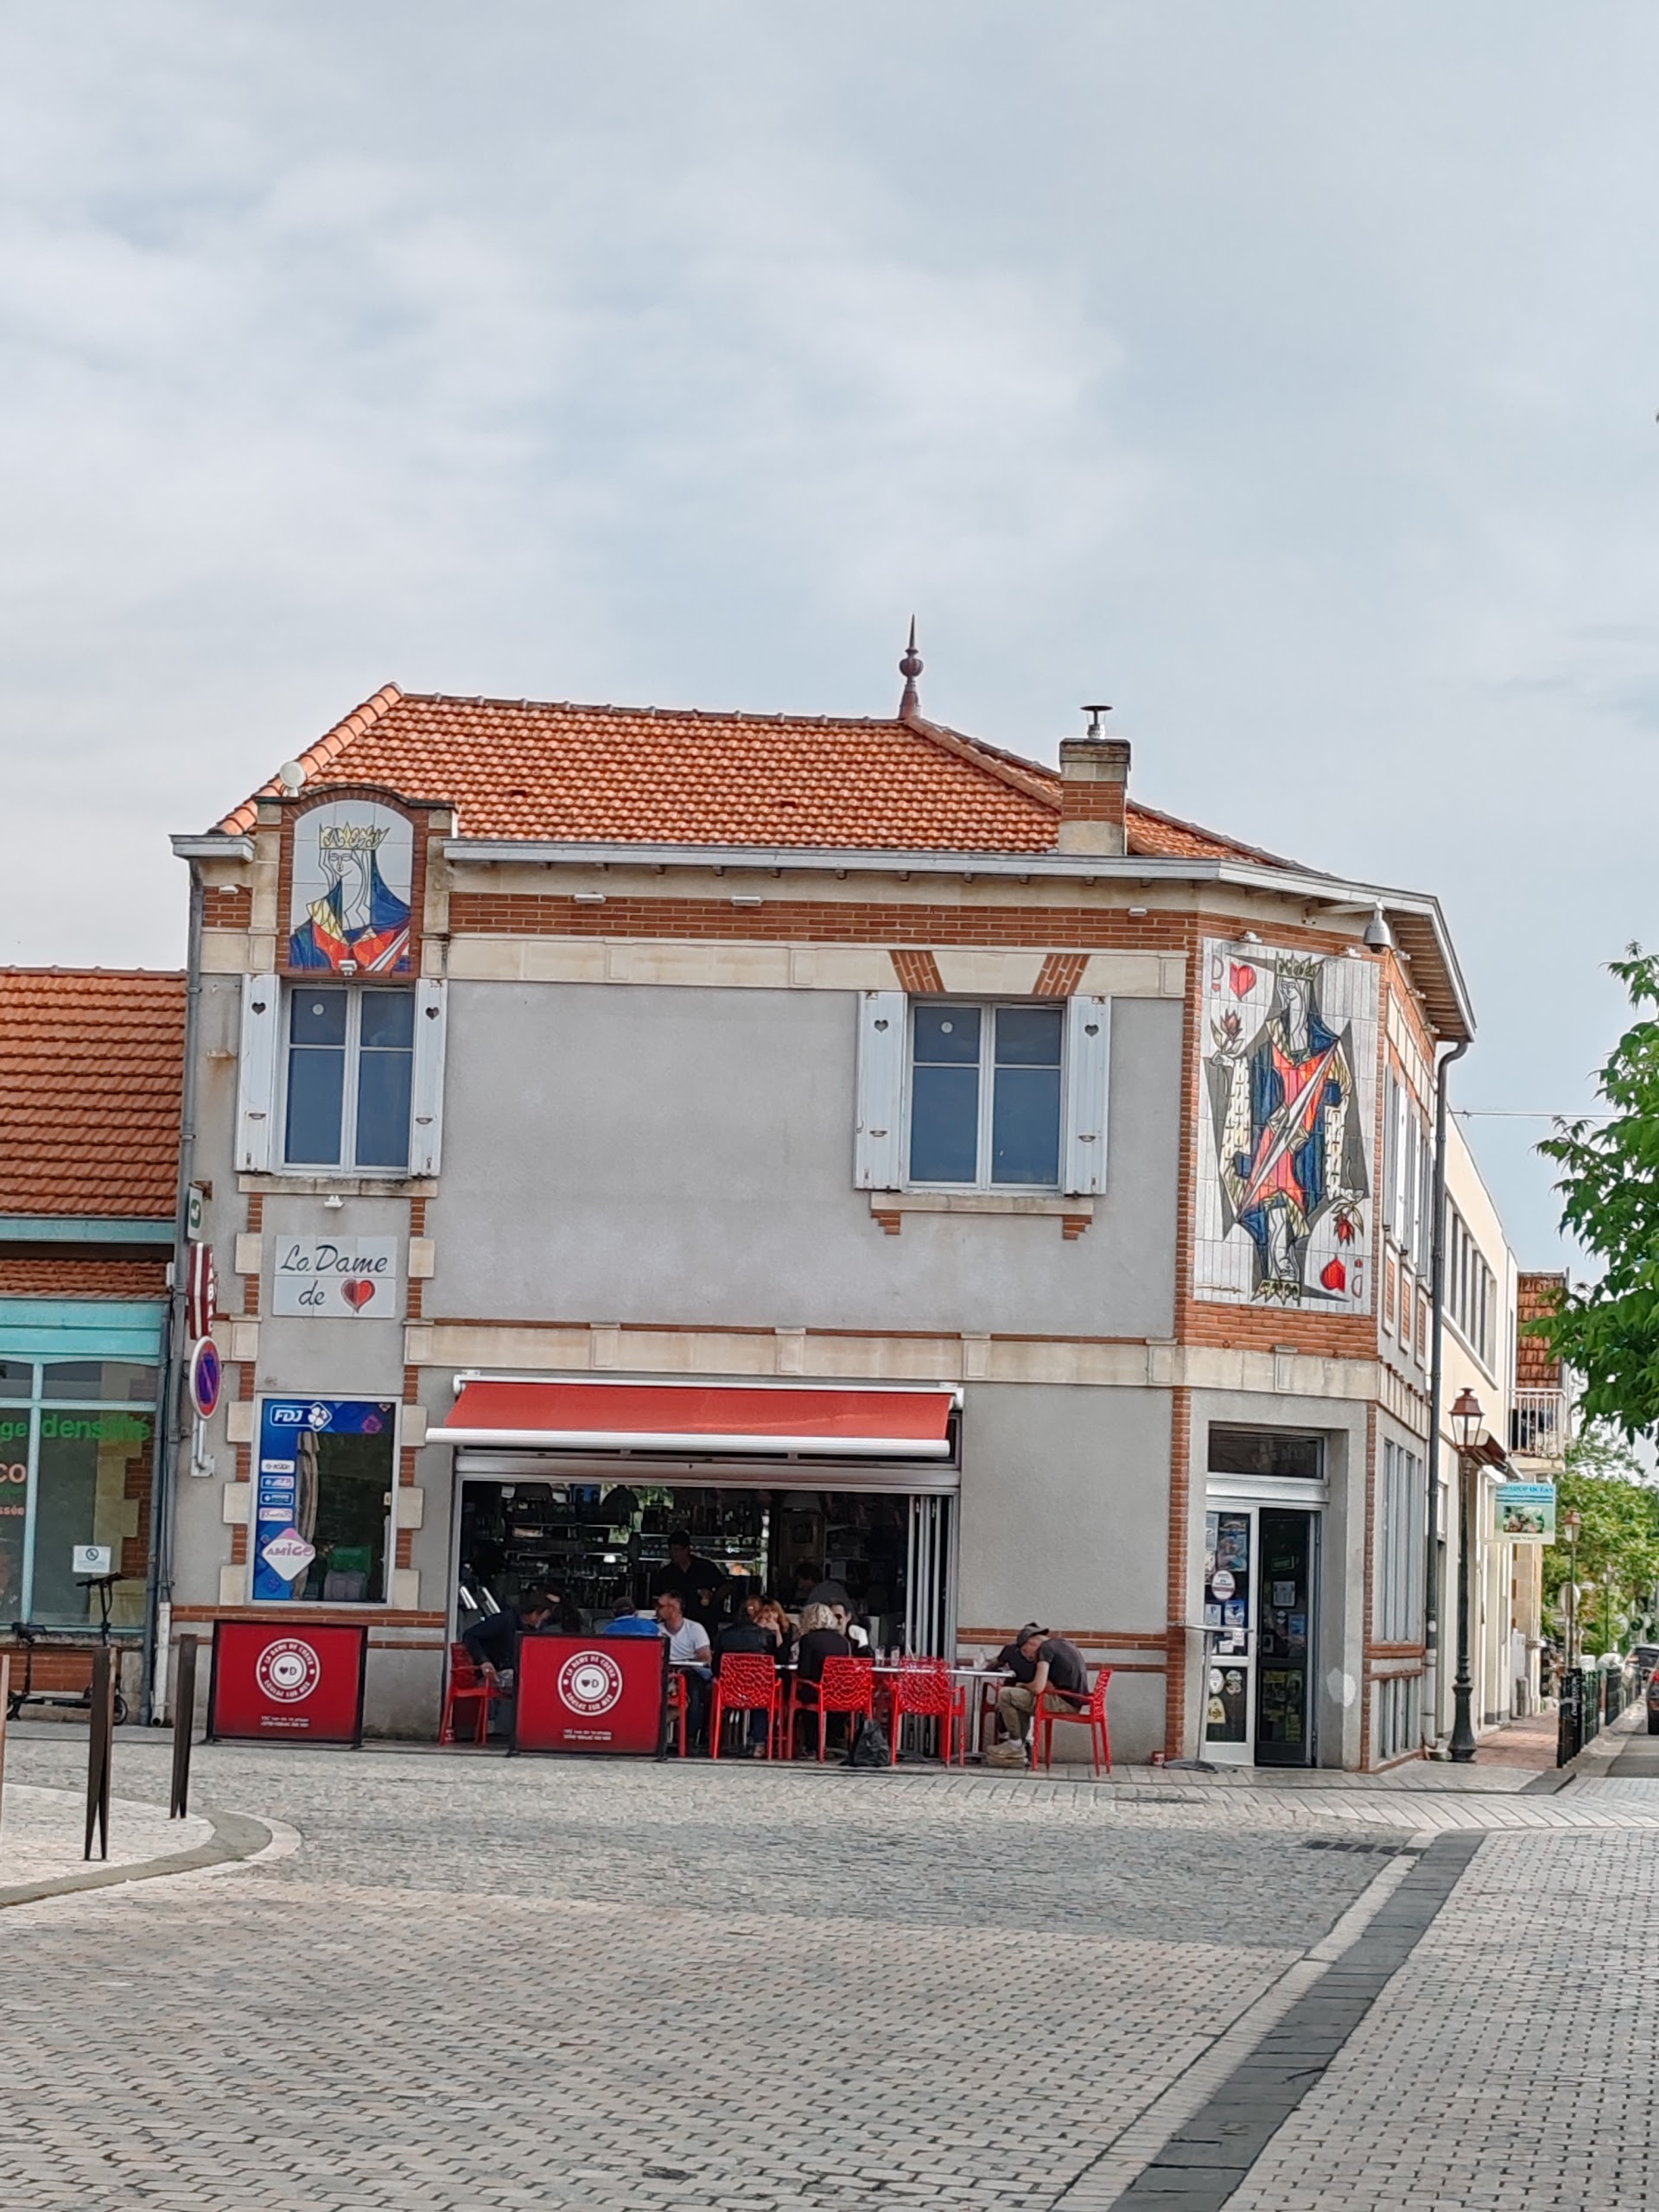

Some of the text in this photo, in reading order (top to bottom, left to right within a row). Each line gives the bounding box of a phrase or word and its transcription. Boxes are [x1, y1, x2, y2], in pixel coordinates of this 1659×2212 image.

[281, 1244, 388, 1273] La Dame
[298, 1279, 326, 1306] de
[274, 1409, 303, 1422] FDJ
[289, 1667, 297, 1675] D
[591, 1679, 599, 1688] D
